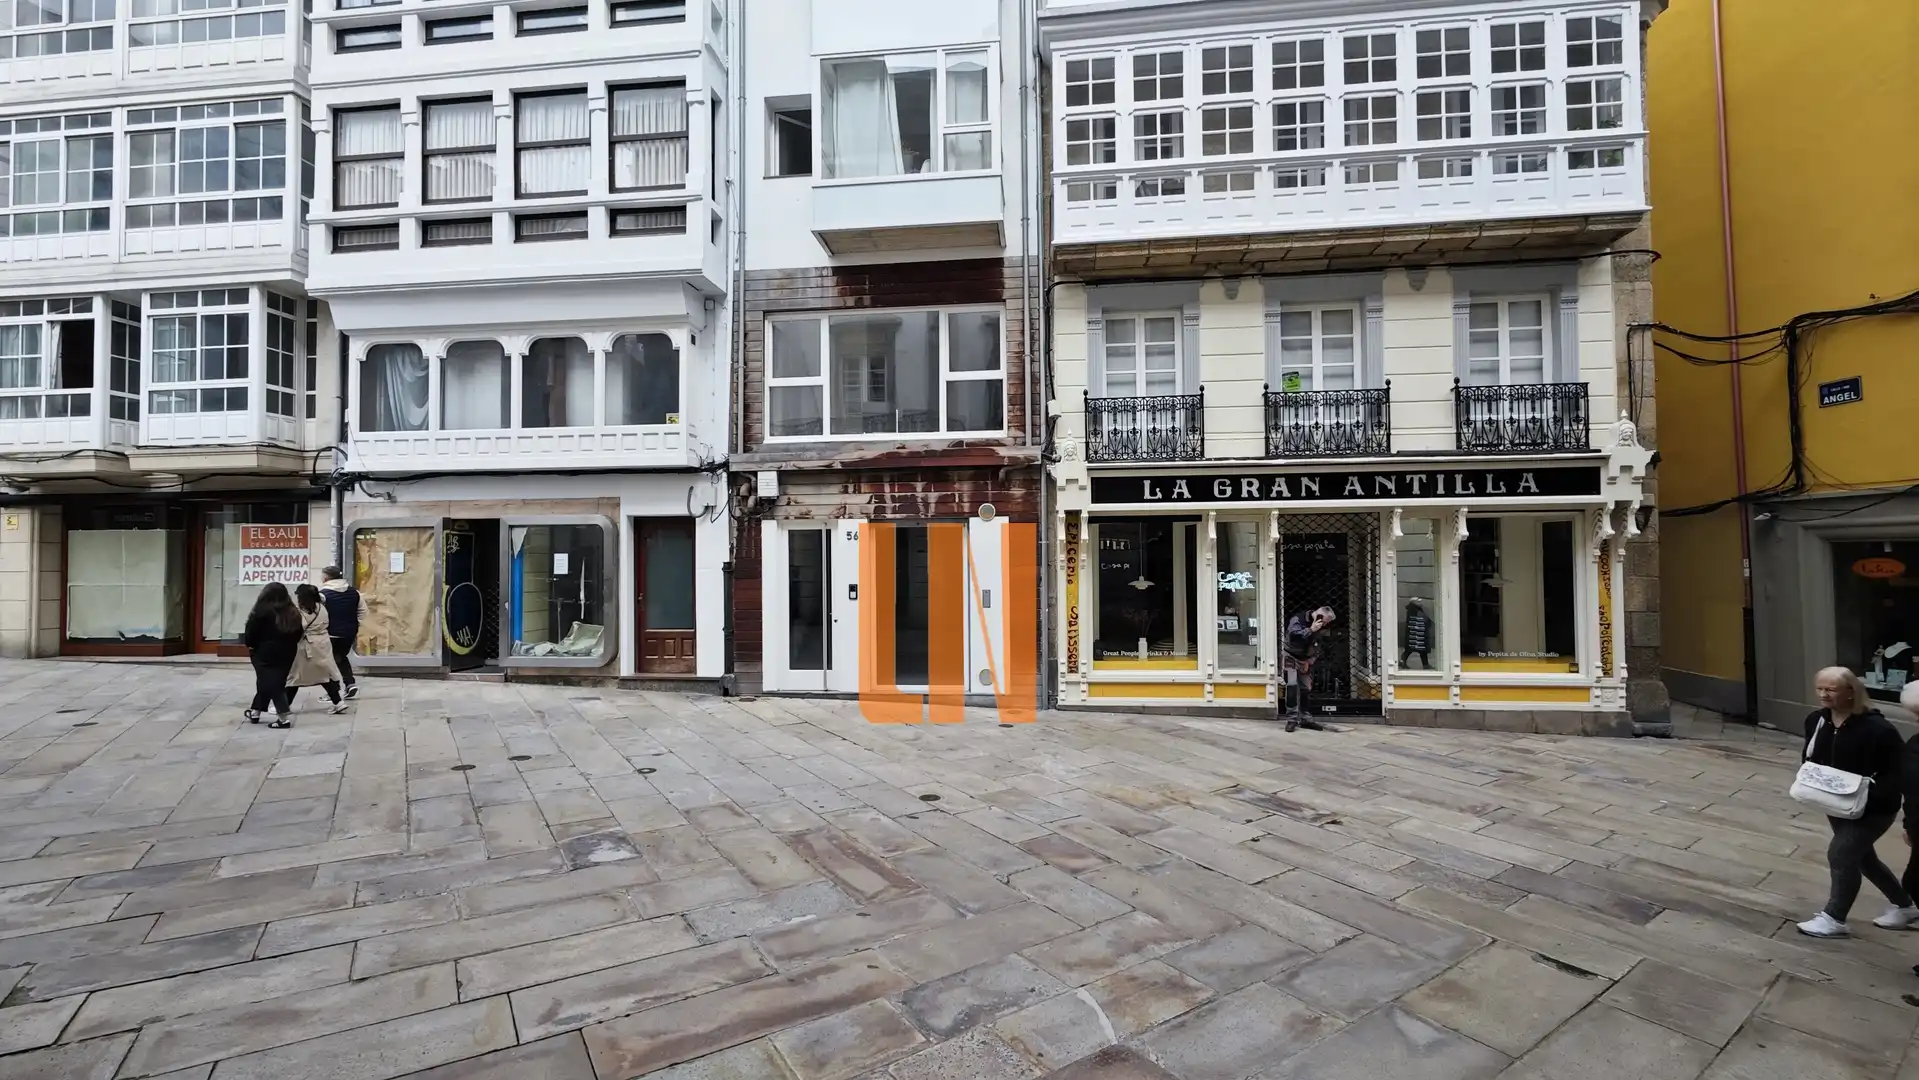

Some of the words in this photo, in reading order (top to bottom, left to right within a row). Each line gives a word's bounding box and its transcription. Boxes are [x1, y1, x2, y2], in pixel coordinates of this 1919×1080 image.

[1823, 391, 1857, 404] ANGEL
[1143, 479, 1192, 500] LA
[1213, 477, 1320, 498] GRAN
[1343, 472, 1540, 496] ANTILLA
[250, 527, 265, 539] EL
[846, 530, 859, 541] 56
[243, 551, 309, 569] PRÓXIMA
[243, 570, 309, 582] APERTURA
